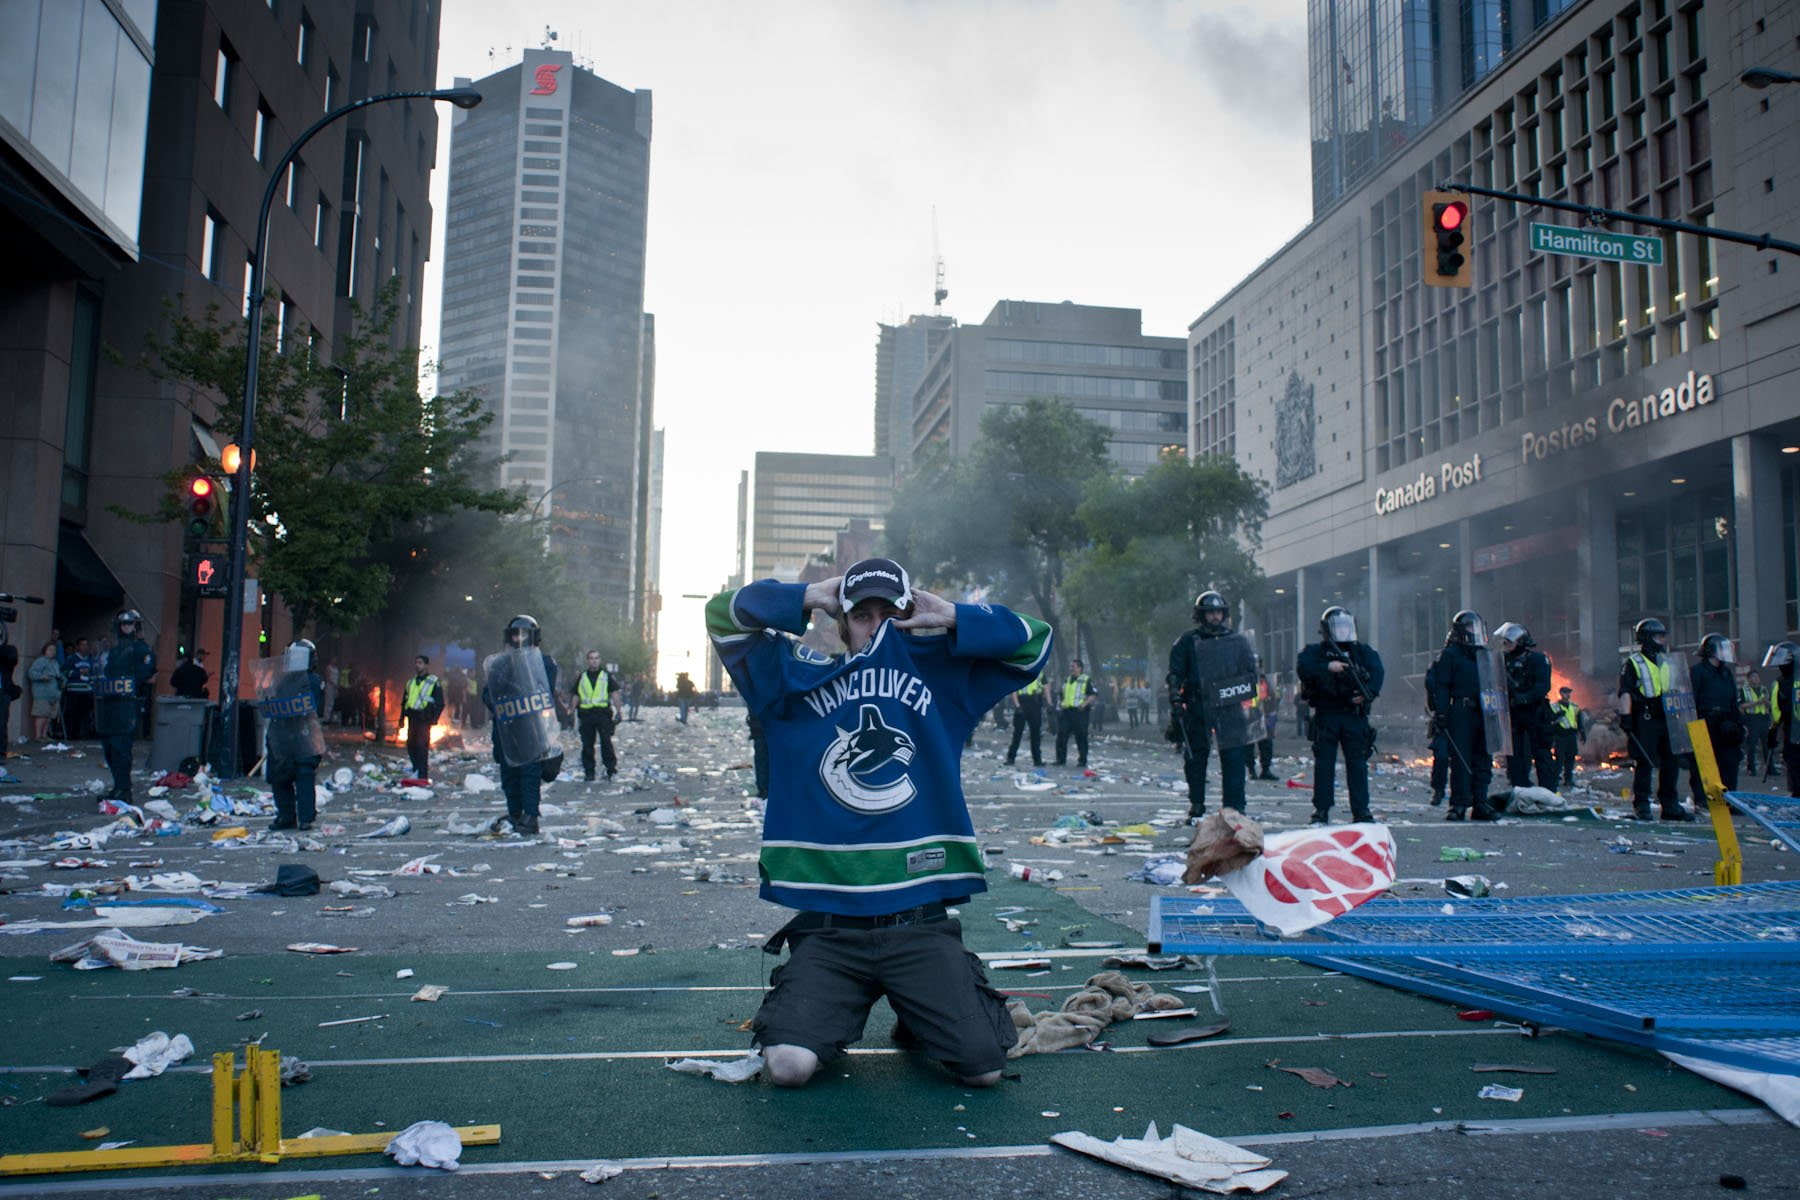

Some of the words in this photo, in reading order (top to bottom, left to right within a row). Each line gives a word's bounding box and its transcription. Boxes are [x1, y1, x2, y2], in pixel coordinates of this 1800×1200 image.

[1540, 228, 1624, 256] Hamilton
[1632, 240, 1654, 259] St
[1522, 417, 1597, 464] Postes
[1607, 370, 1714, 433] Canada
[1375, 472, 1436, 516] Canada
[1441, 453, 1482, 493] Post
[846, 570, 899, 587] TaylorMade
[496, 692, 552, 720] POLICE
[803, 667, 932, 718] VANCOUVER
[1219, 682, 1252, 699] POLICE
